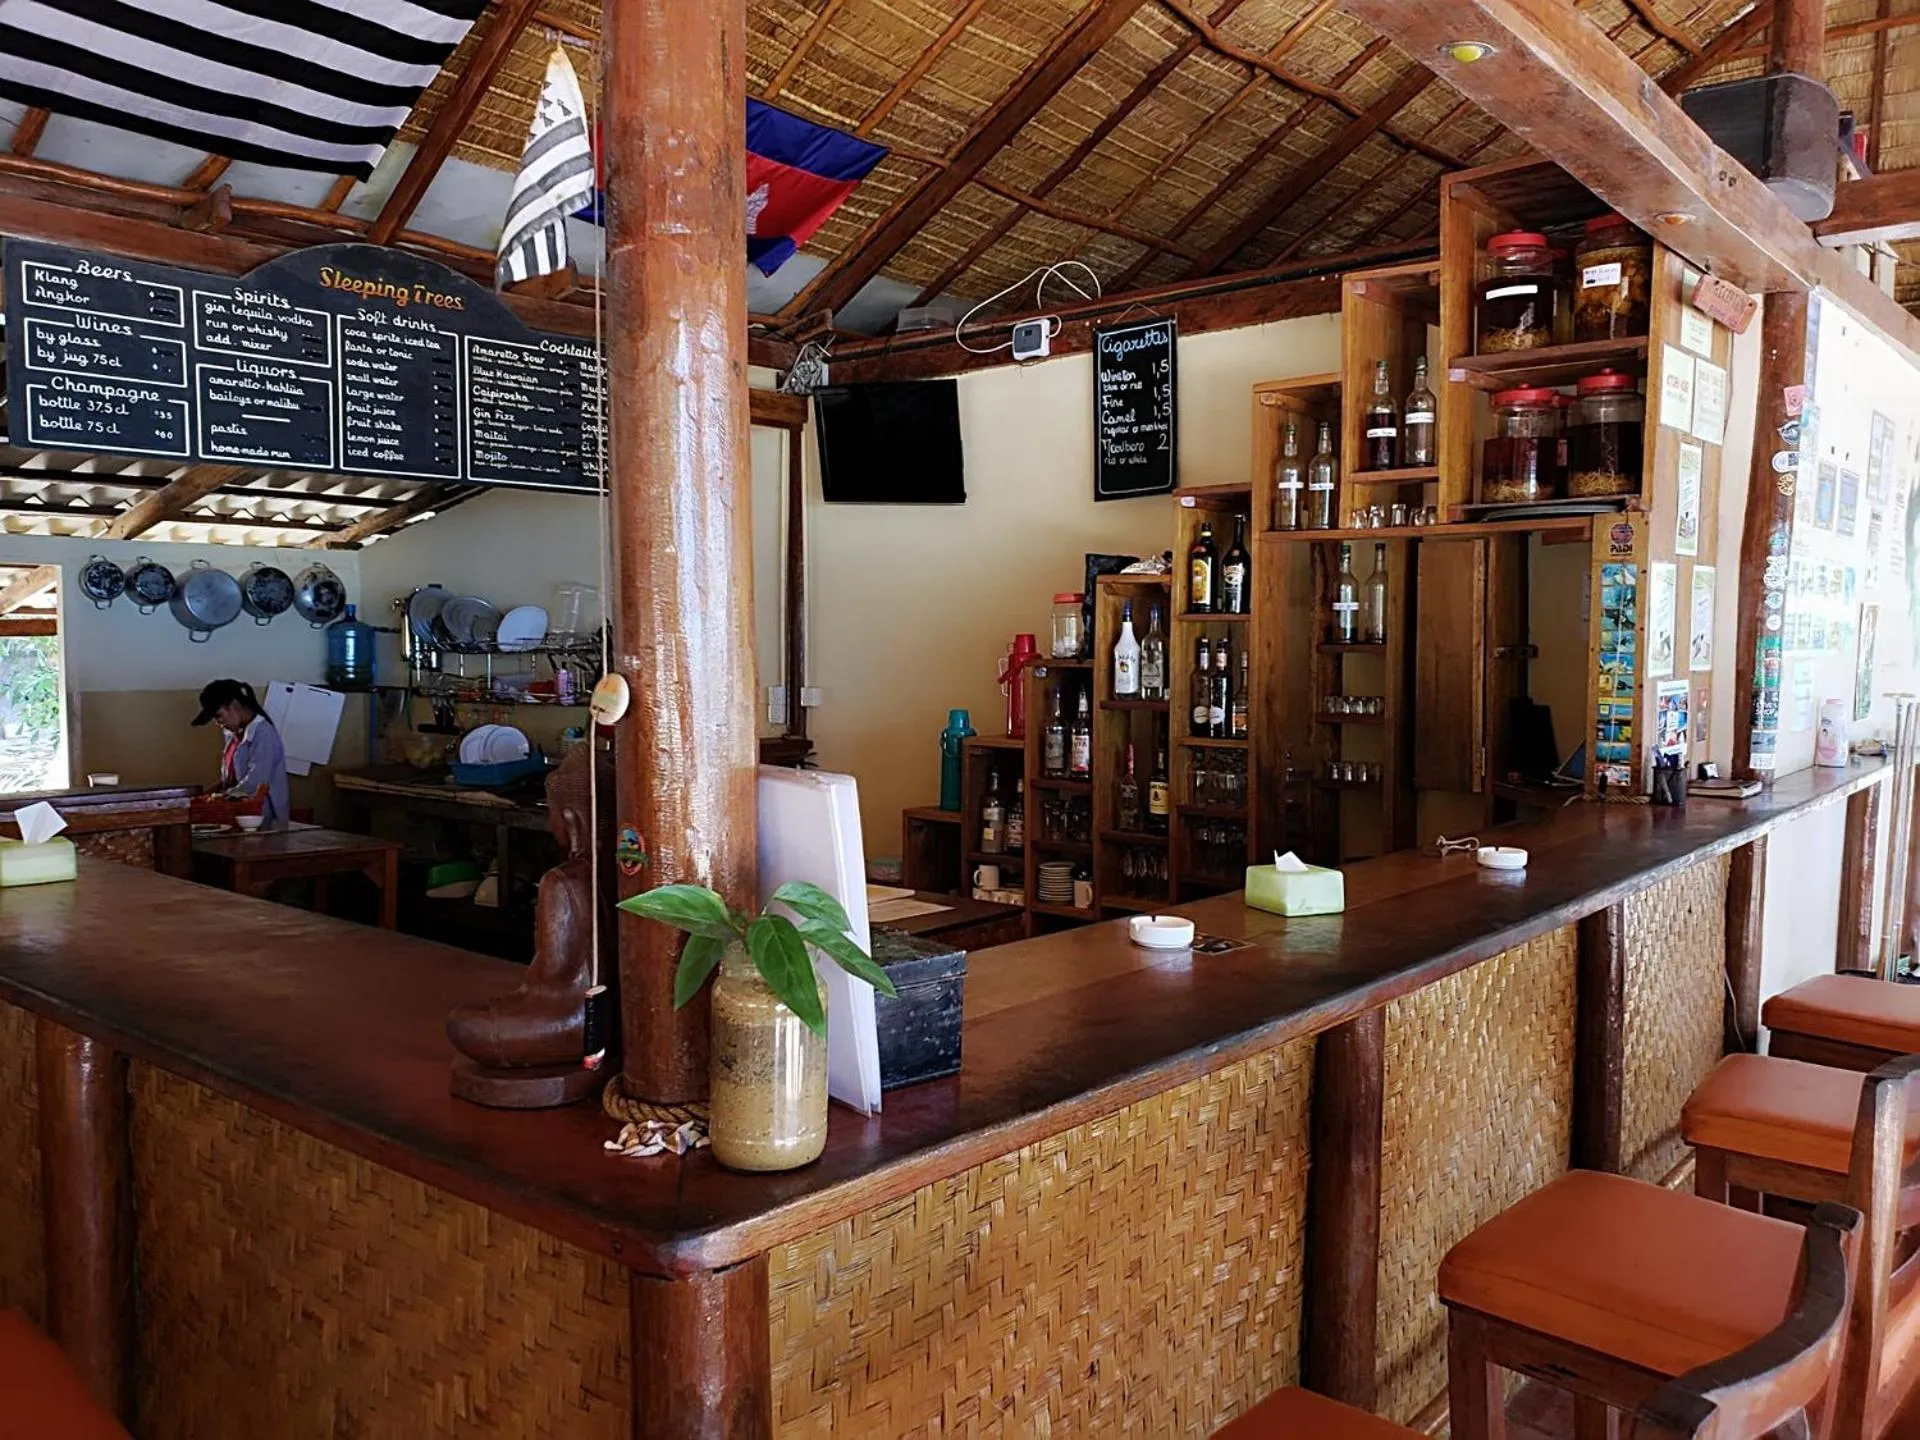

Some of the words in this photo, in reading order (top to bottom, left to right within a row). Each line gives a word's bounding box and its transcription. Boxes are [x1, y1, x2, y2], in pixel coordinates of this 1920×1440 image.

[35, 269, 79, 290] Klang
[75, 259, 133, 282] Beers
[35, 285, 91, 305] Angkor
[233, 287, 291, 309] Spirits
[319, 266, 409, 307] Sleeping
[413, 284, 465, 311] Trees
[75, 314, 133, 336] Wines
[278, 314, 314, 327] vodka
[357, 307, 389, 326] Soft
[392, 314, 436, 333] drinks
[36, 327, 56, 344] by
[58, 332, 102, 347] glass
[205, 319, 229, 330] rum
[232, 323, 246, 332] or
[246, 324, 289, 342] whisky
[36, 344, 57, 363] by
[62, 348, 89, 367] jug
[375, 347, 388, 355] or
[540, 339, 599, 360] Cocktails
[50, 376, 160, 403] Champagne
[38, 394, 82, 410] bottle
[254, 398, 266, 406] or
[39, 414, 84, 431] bottle
[473, 407, 491, 419] Gin
[1101, 408, 1137, 425] Camel
[1156, 433, 1169, 450] 2
[1610, 544, 1633, 553] PADI
